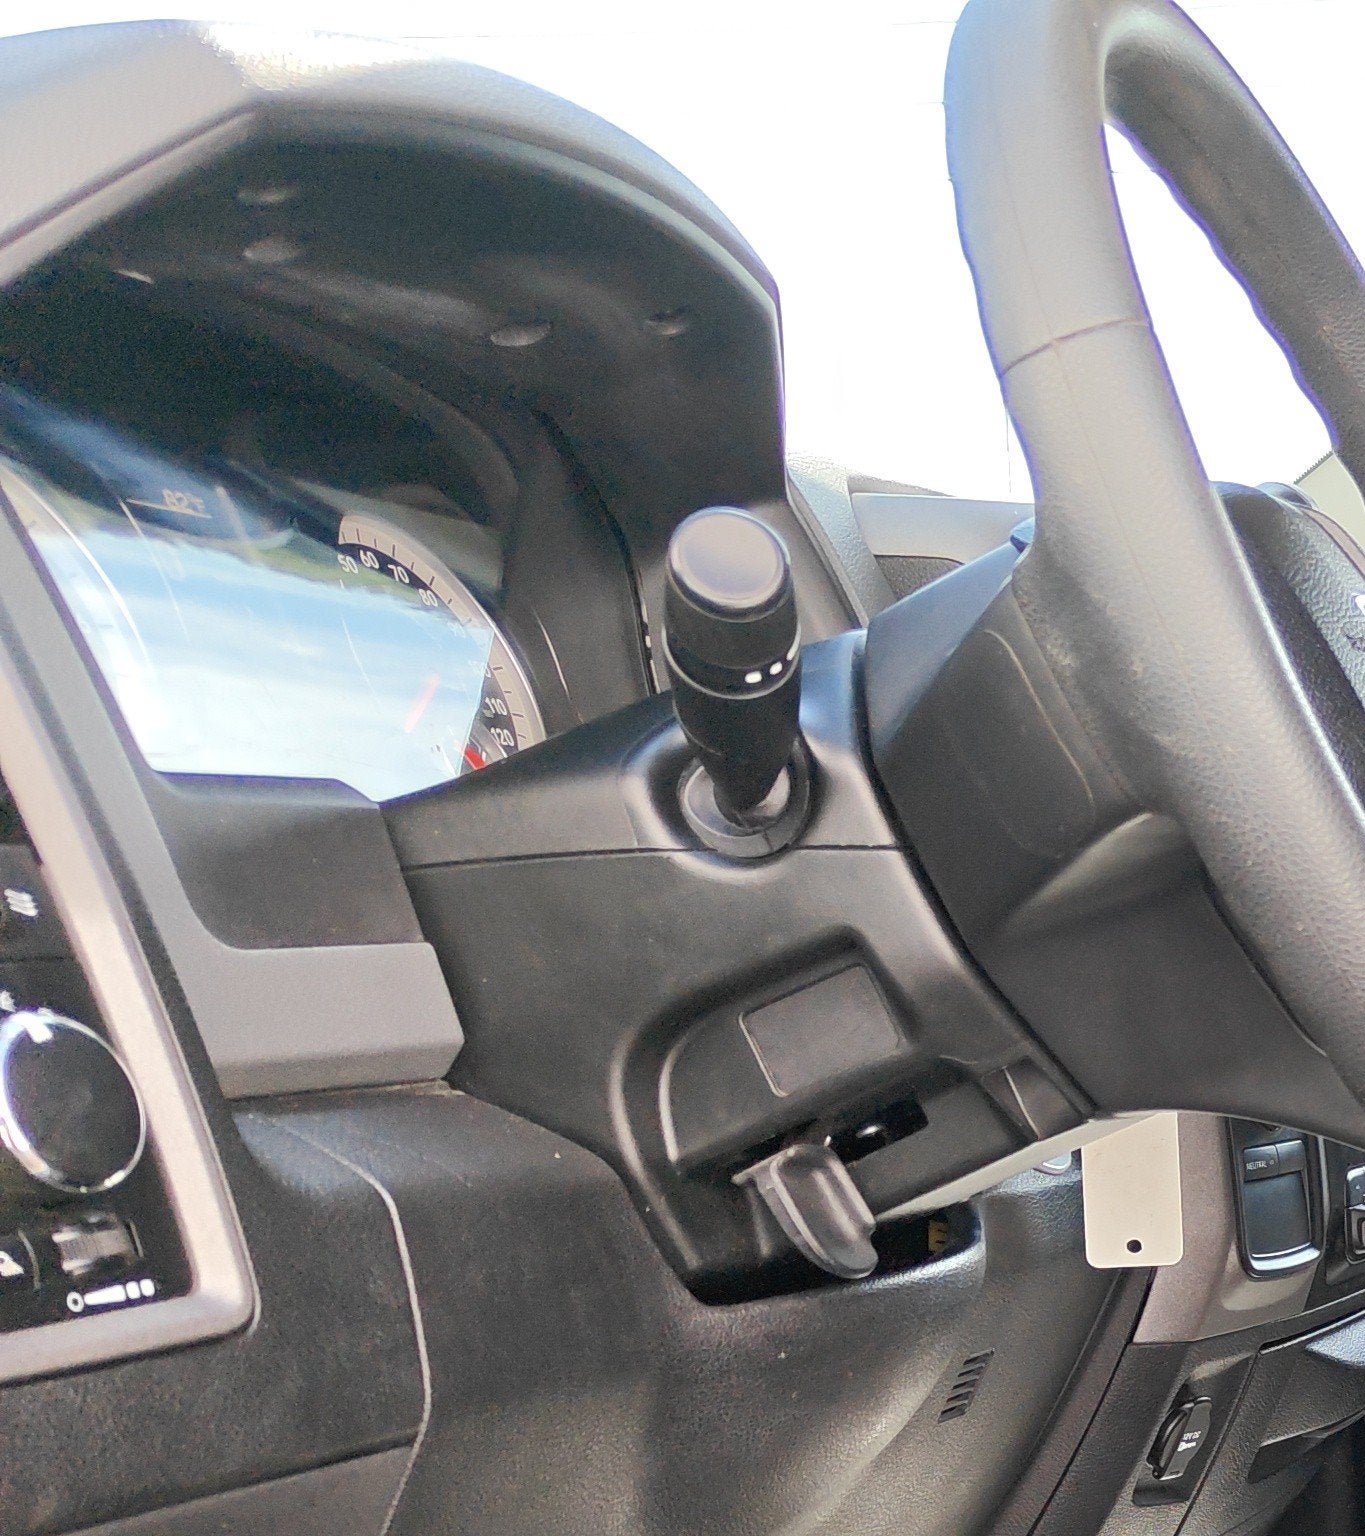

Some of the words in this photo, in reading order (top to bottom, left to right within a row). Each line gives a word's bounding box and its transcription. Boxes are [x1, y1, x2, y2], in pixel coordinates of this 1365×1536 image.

[337, 553, 359, 574] 50
[359, 549, 380, 570] 60
[387, 563, 410, 584] 70
[417, 588, 439, 607] 80
[484, 696, 508, 716] 110
[490, 726, 515, 747] 120
